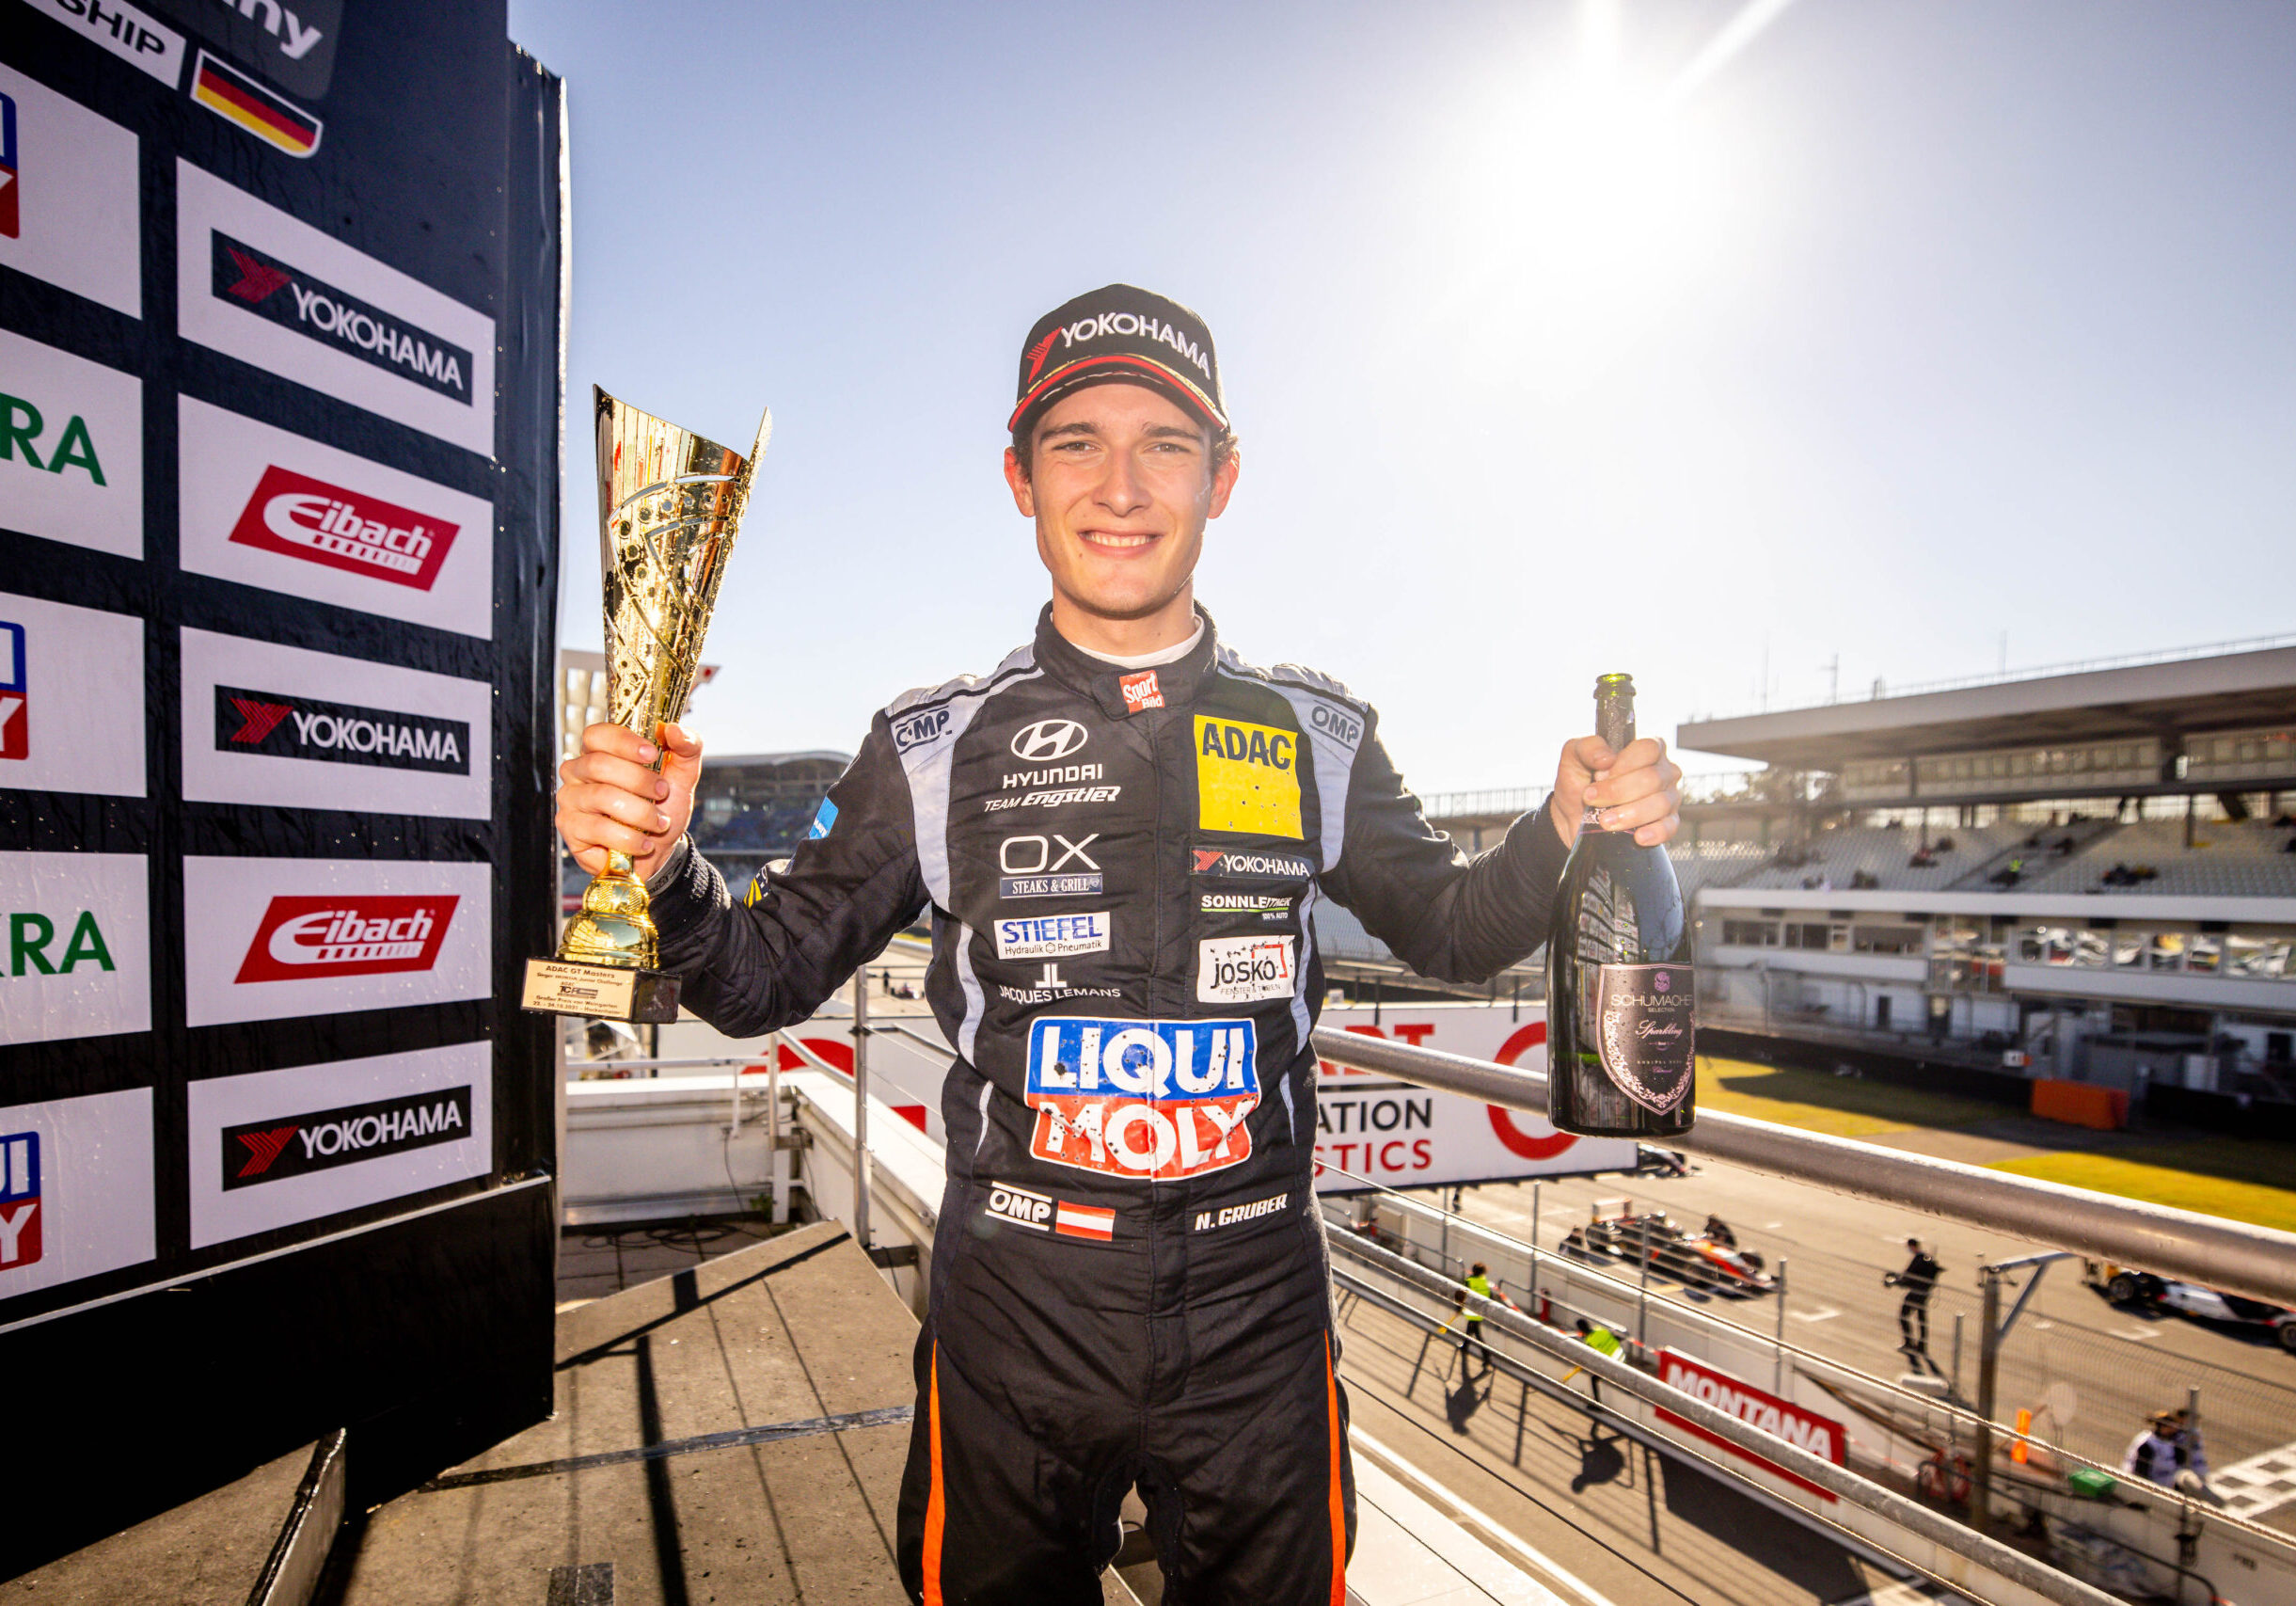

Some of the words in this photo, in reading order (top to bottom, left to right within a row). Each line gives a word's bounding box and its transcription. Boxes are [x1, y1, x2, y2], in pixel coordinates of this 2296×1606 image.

[221, 0, 323, 59] ny
[291, 281, 463, 391] YOKOHAMA
[1061, 312, 1211, 380] YOKOHAMA
[263, 492, 433, 564] Eibach
[1122, 675, 1159, 704] Sport
[1142, 695, 1163, 708] Bild
[293, 710, 461, 763] YOKOHAMA
[1311, 705, 1360, 743] OMP
[1202, 723, 1292, 771] ADAC
[1002, 763, 1103, 789] HYUNDAI
[984, 797, 1022, 813] TEAM
[999, 834, 1101, 874] OX
[1223, 854, 1310, 877] YOKOHAMA
[1012, 880, 1049, 894] STEAKS
[1051, 879, 1059, 893] &
[1061, 877, 1089, 892] GRILL
[0, 910, 116, 978] RA
[268, 909, 433, 964] Eibach
[1002, 915, 1102, 944] STIEFEL
[1005, 945, 1044, 956] Hydraulik
[1058, 942, 1102, 952] Pneumatik
[546, 965, 568, 974] ADAC
[583, 970, 615, 978] Masters
[999, 984, 1053, 1005] JACQUES
[1054, 988, 1121, 1000] LEMANS
[1040, 1026, 1245, 1099] LIQUI
[300, 1100, 463, 1158] YOKOHAMA
[1038, 1100, 1257, 1171] MOLY
[990, 1188, 1052, 1223] OMP
[1195, 1213, 1215, 1231] N.
[1218, 1193, 1288, 1225] GRUBER
[1668, 1363, 1833, 1462] MONTANA
